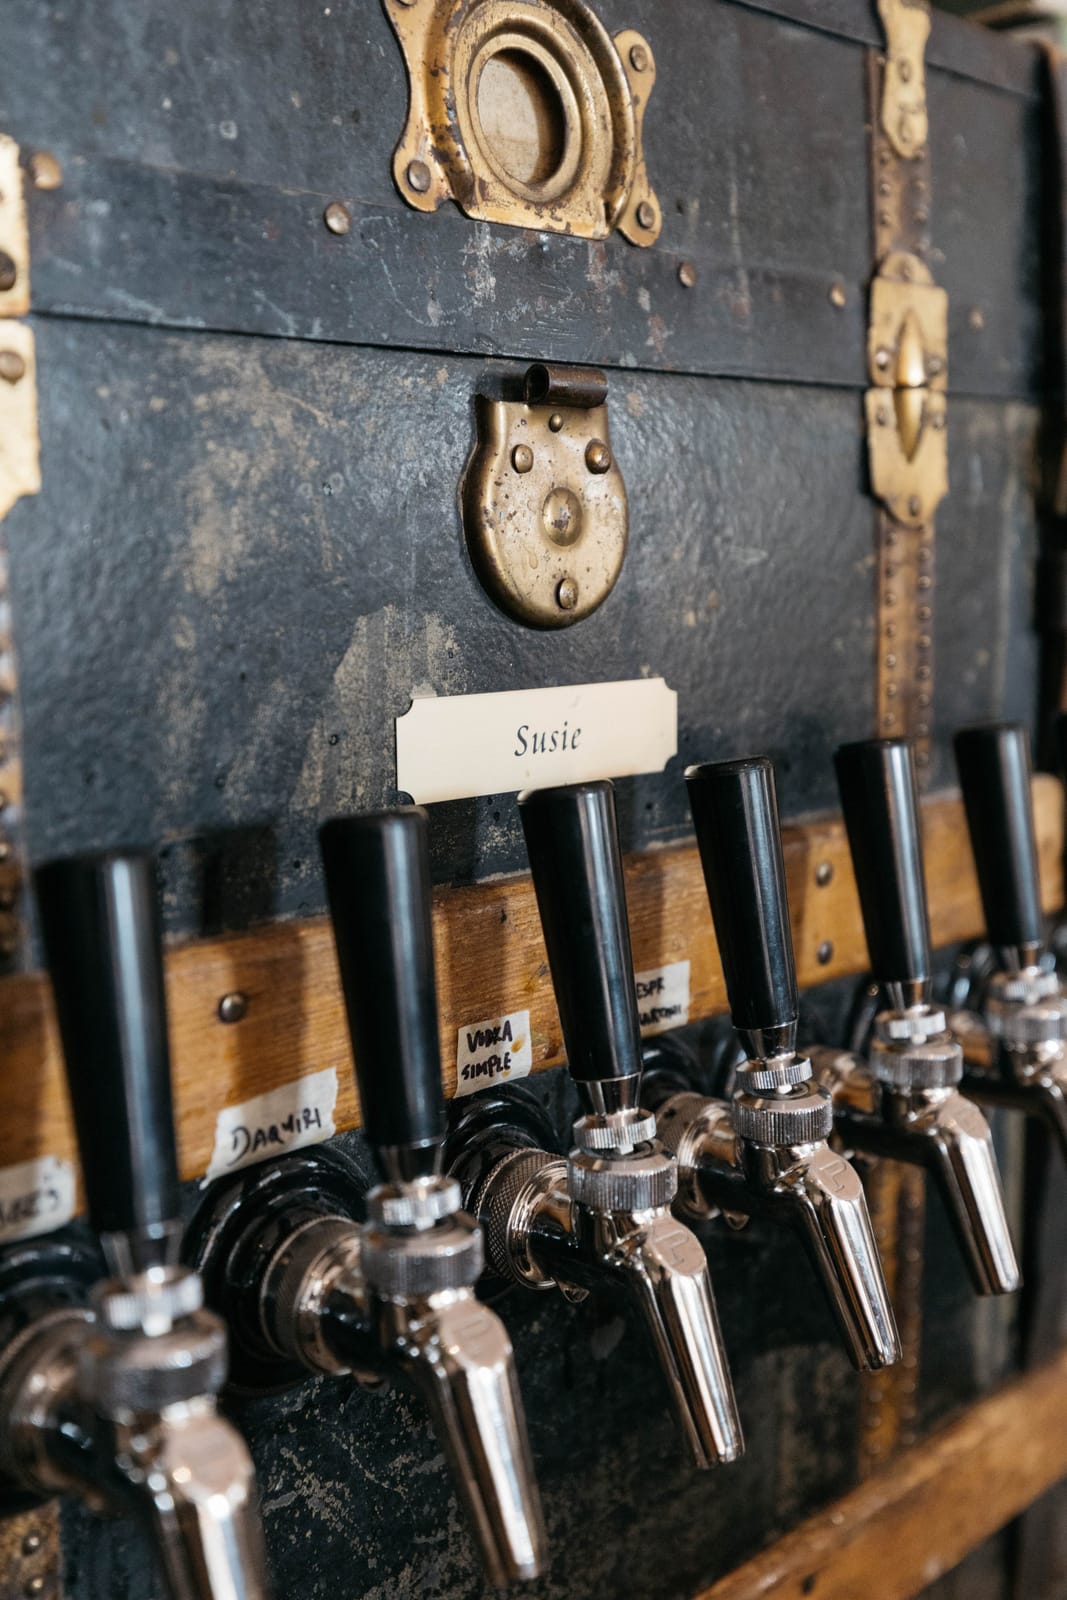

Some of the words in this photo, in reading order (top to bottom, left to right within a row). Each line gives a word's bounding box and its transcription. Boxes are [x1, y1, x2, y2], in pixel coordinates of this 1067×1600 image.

[514, 721, 582, 757] Susie
[466, 1020, 513, 1053] VODKA
[461, 1052, 512, 1080] SIMPLE
